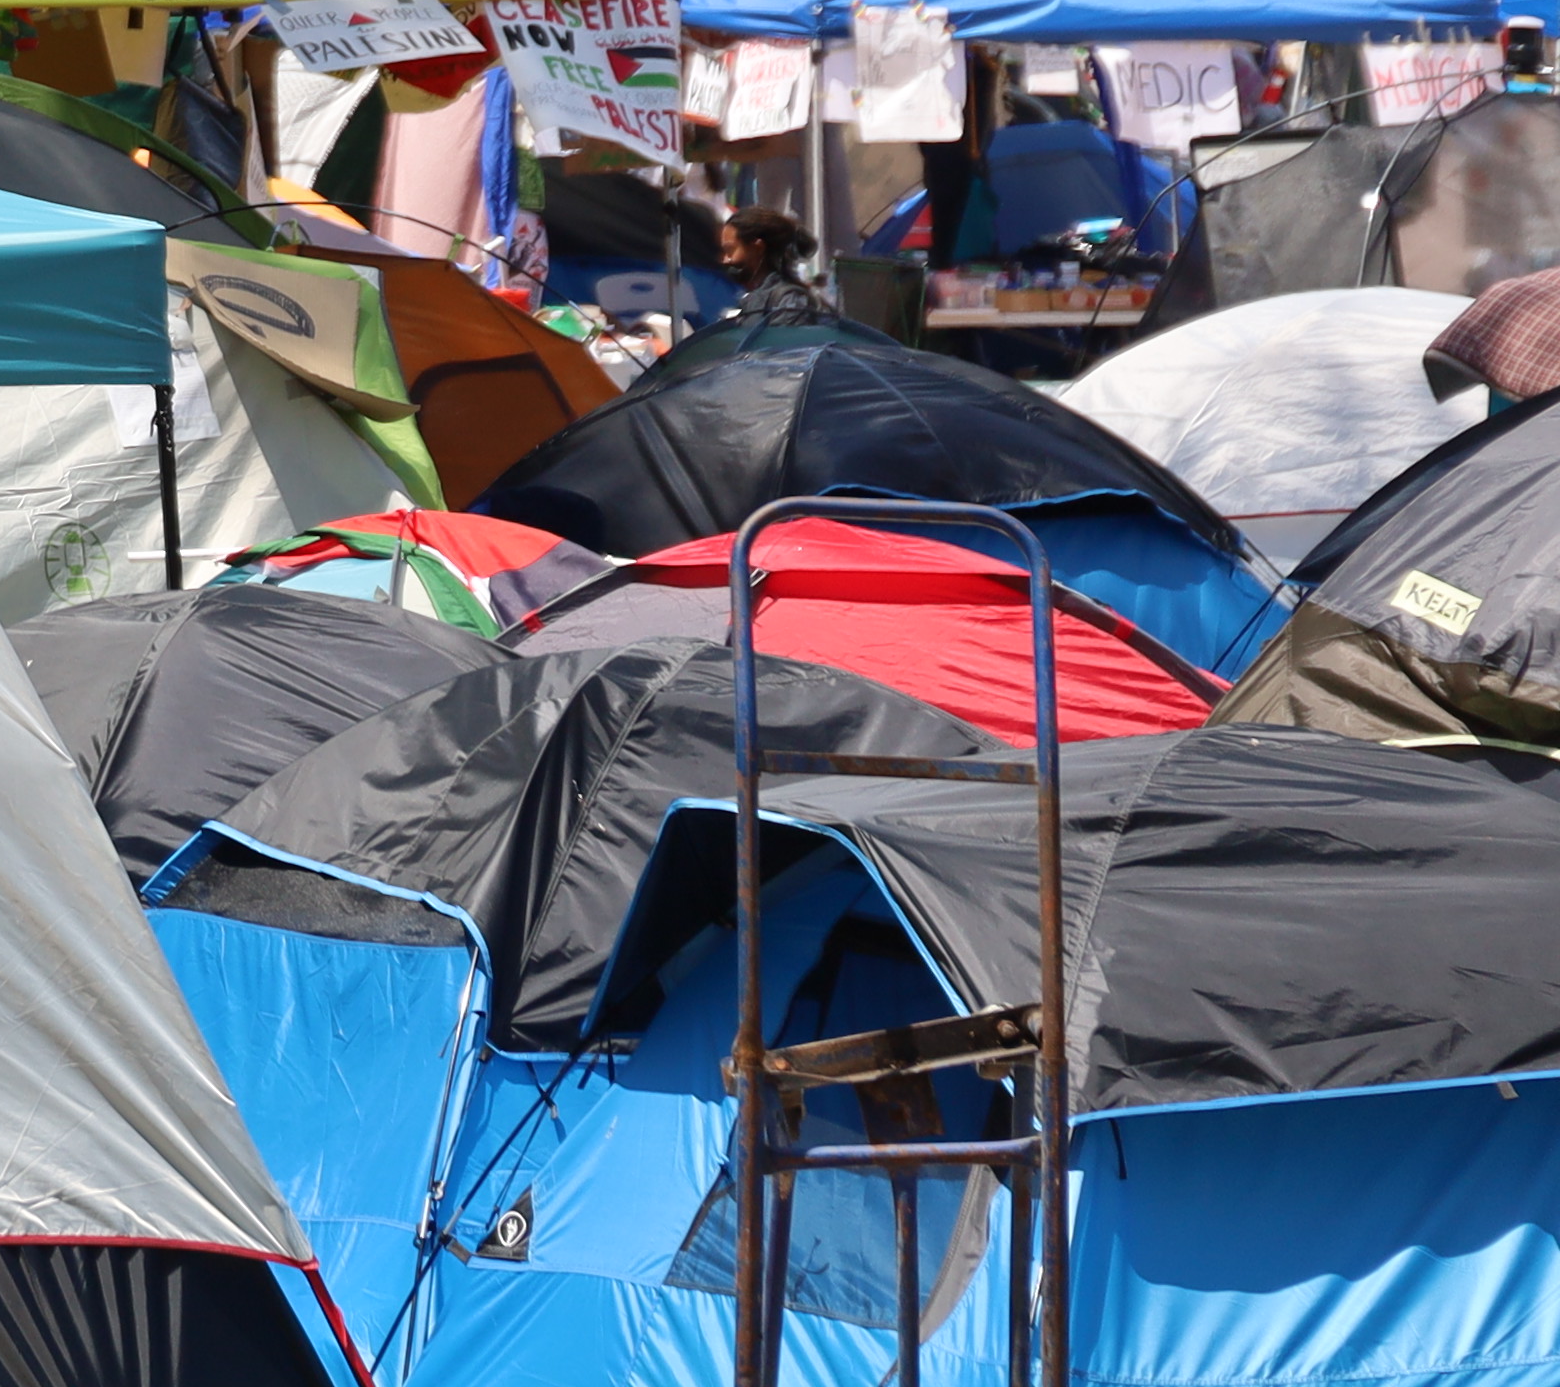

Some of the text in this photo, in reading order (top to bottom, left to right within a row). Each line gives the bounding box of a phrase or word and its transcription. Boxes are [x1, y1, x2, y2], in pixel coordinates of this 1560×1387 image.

[279, 11, 346, 32] QUEER
[373, 6, 442, 21] PEOPLE
[294, 26, 475, 64] PALESTINE
[502, 24, 575, 55] NOW
[542, 55, 613, 93] FREE
[1116, 59, 1237, 113] MEDIC
[591, 94, 681, 153] PALEST
[1405, 582, 1479, 626] KELTY
